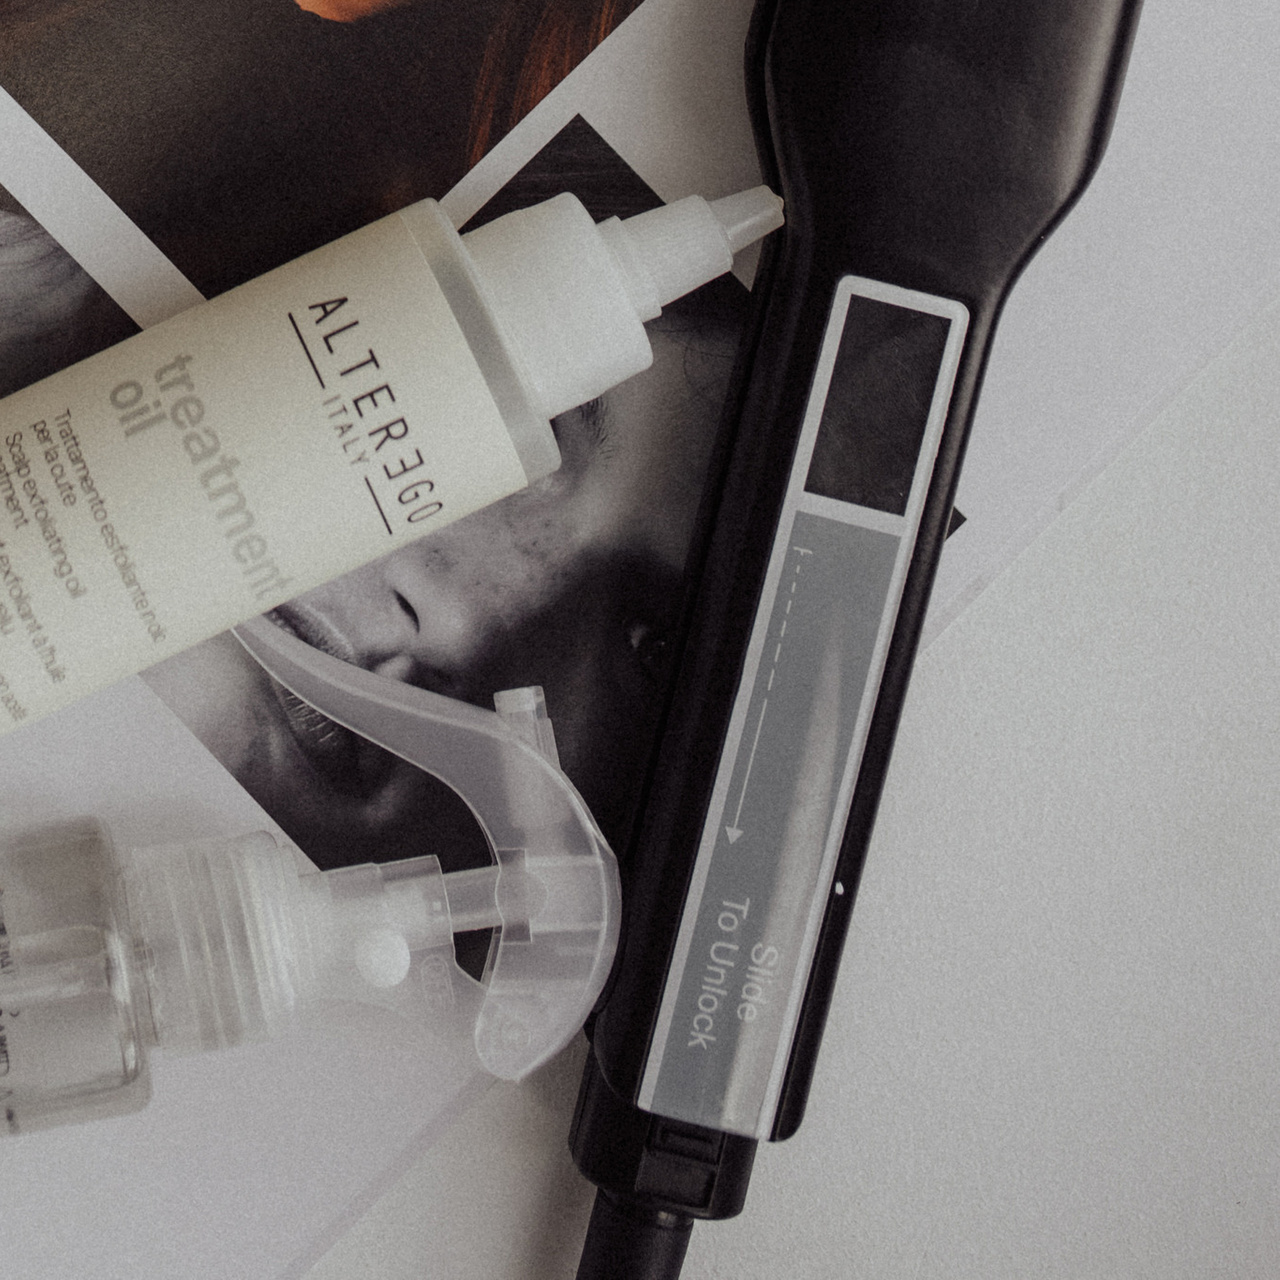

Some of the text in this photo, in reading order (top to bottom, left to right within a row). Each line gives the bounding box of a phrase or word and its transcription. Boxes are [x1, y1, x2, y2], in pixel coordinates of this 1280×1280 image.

[28, 417, 80, 508] per la cute
[107, 377, 167, 438] oil
[320, 393, 370, 469] ITALY
[3, 430, 88, 600] Scalp exfoliating oil
[51, 408, 110, 524] Trattamento
[97, 521, 152, 611] esfoliante
[152, 350, 291, 601] treatment
[687, 896, 751, 1051] To Unlock
[736, 942, 780, 1024] Slide
